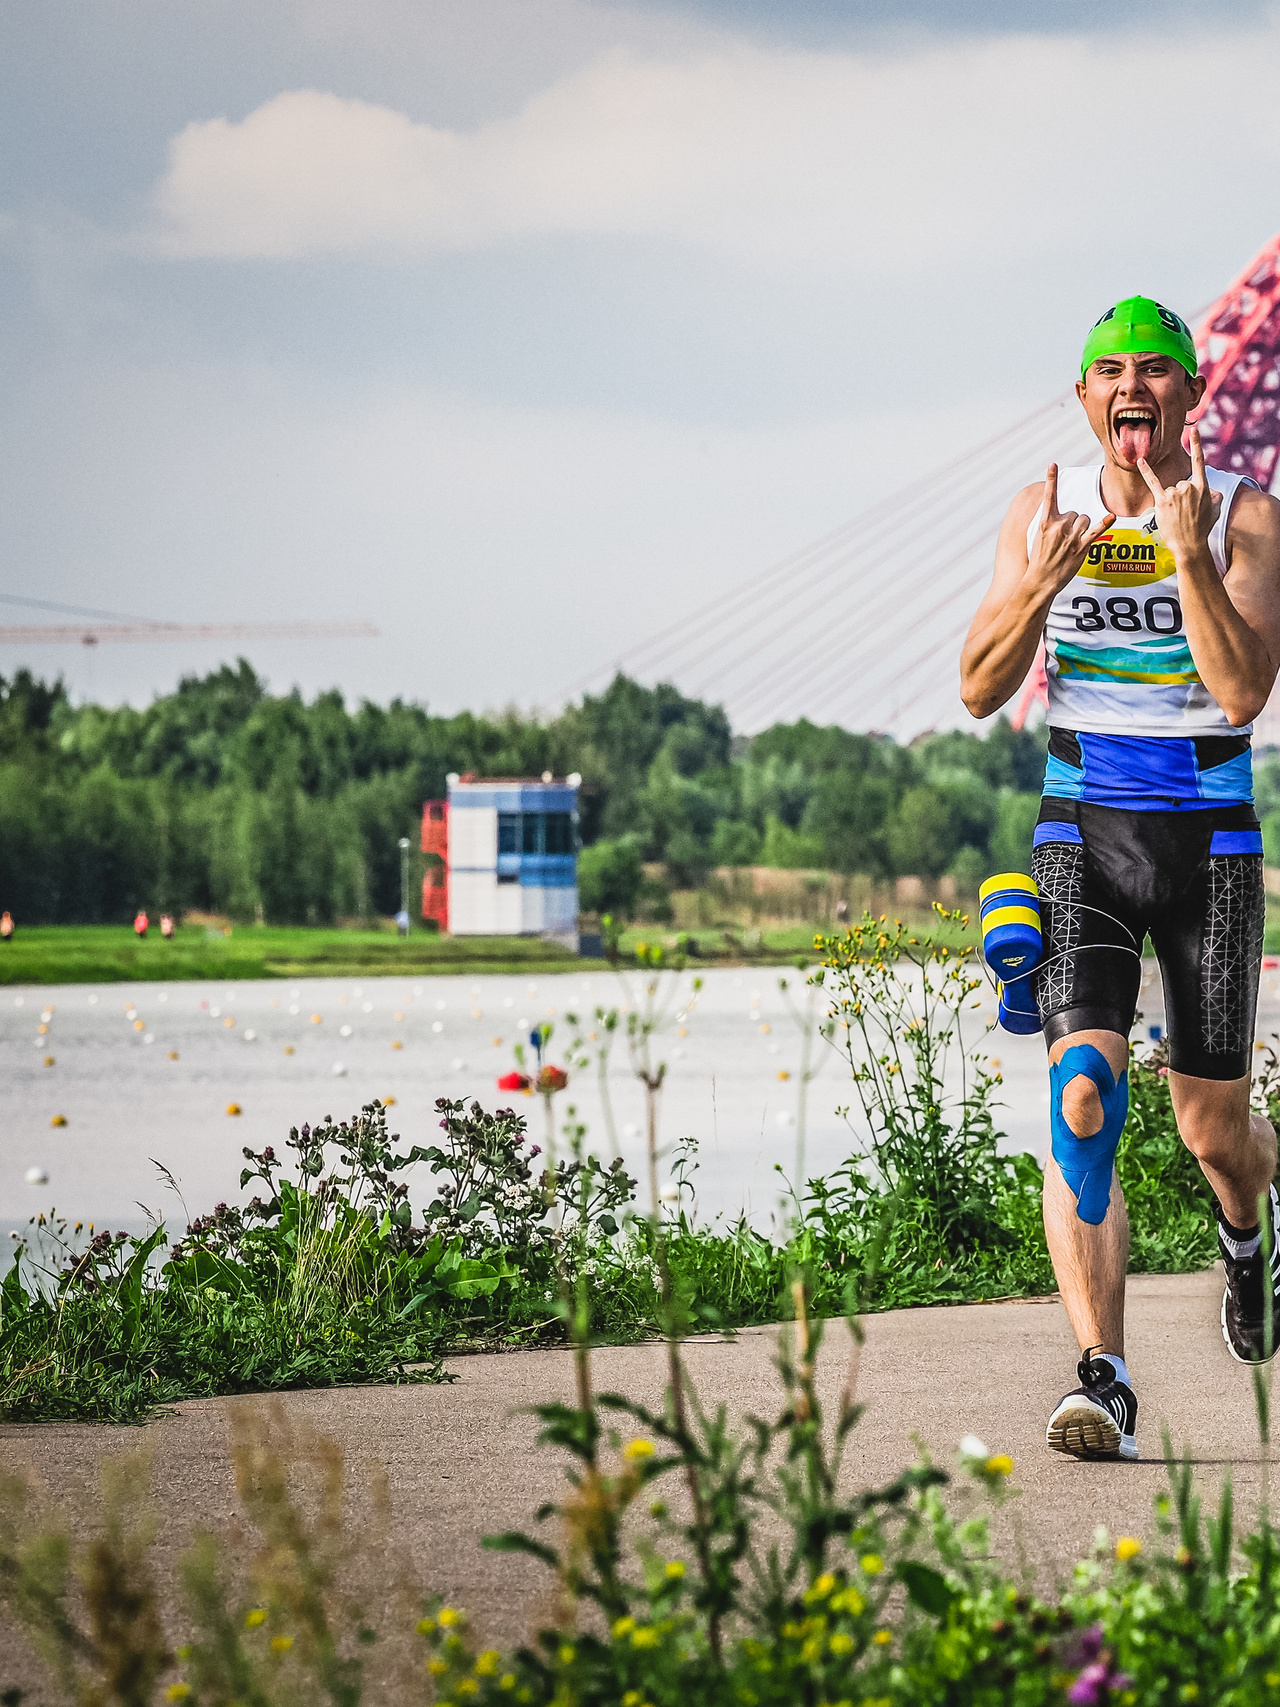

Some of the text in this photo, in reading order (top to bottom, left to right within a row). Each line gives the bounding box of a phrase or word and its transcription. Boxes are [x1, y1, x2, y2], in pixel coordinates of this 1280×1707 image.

[1087, 542, 1155, 565] grom
[1106, 563, 1152, 572] SWIM&RUN
[1071, 596, 1183, 634] 380
